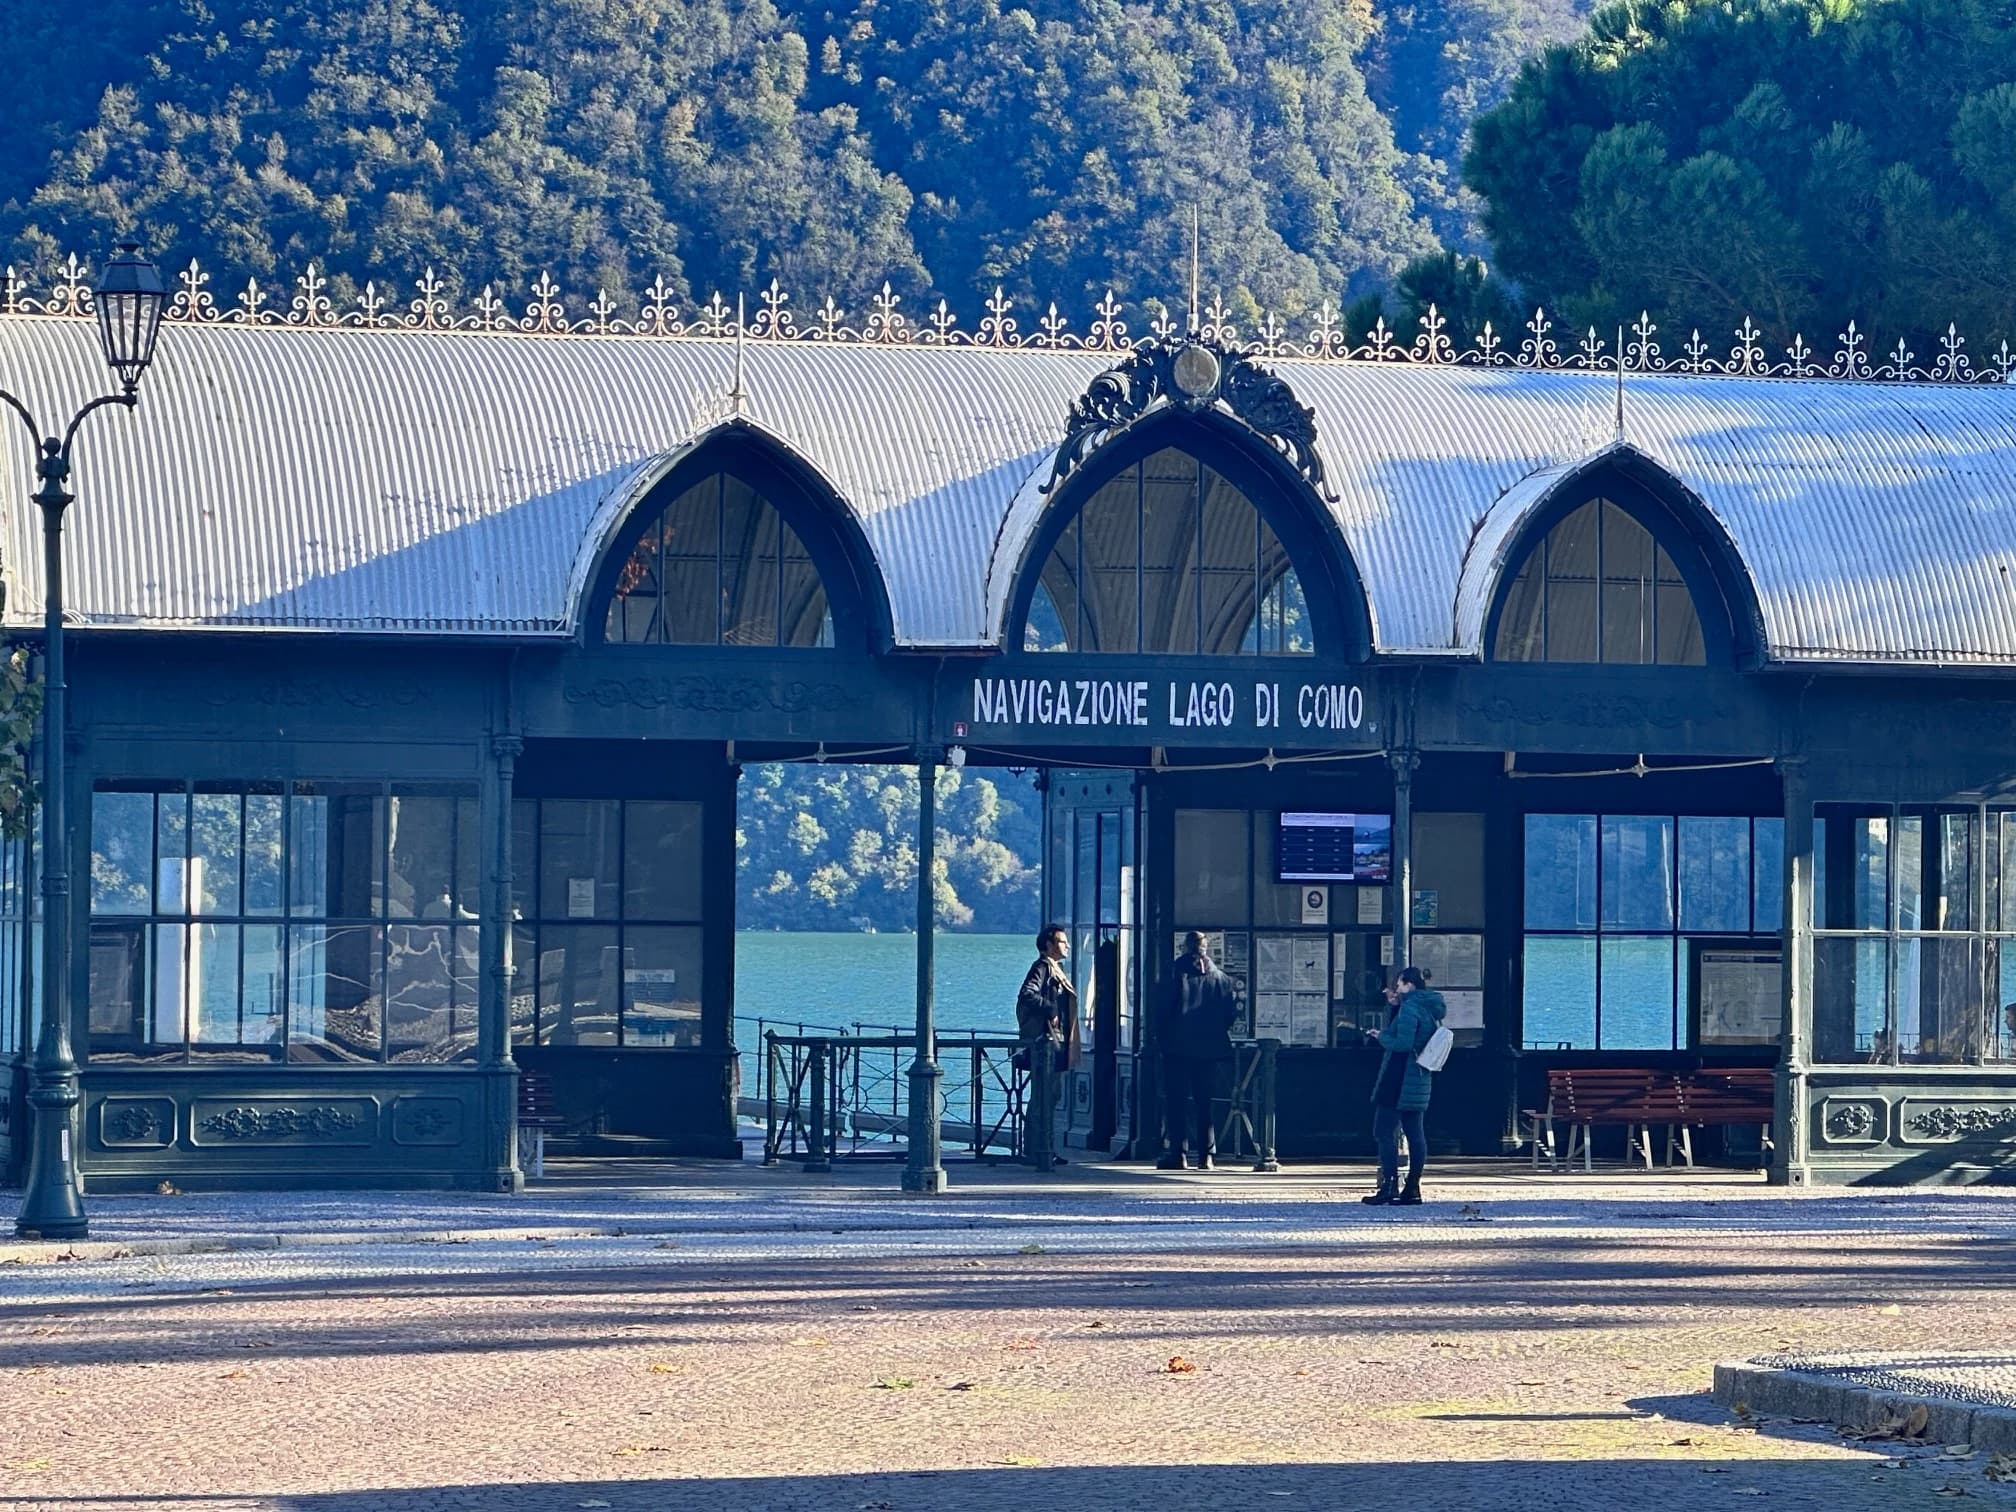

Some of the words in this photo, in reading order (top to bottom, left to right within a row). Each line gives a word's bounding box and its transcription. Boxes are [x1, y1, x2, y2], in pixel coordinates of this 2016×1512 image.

[974, 678, 1148, 726] NAVIGAZIONE
[1169, 682, 1234, 727] LAGO
[1256, 683, 1279, 728] DI
[1298, 684, 1363, 729] COMO
